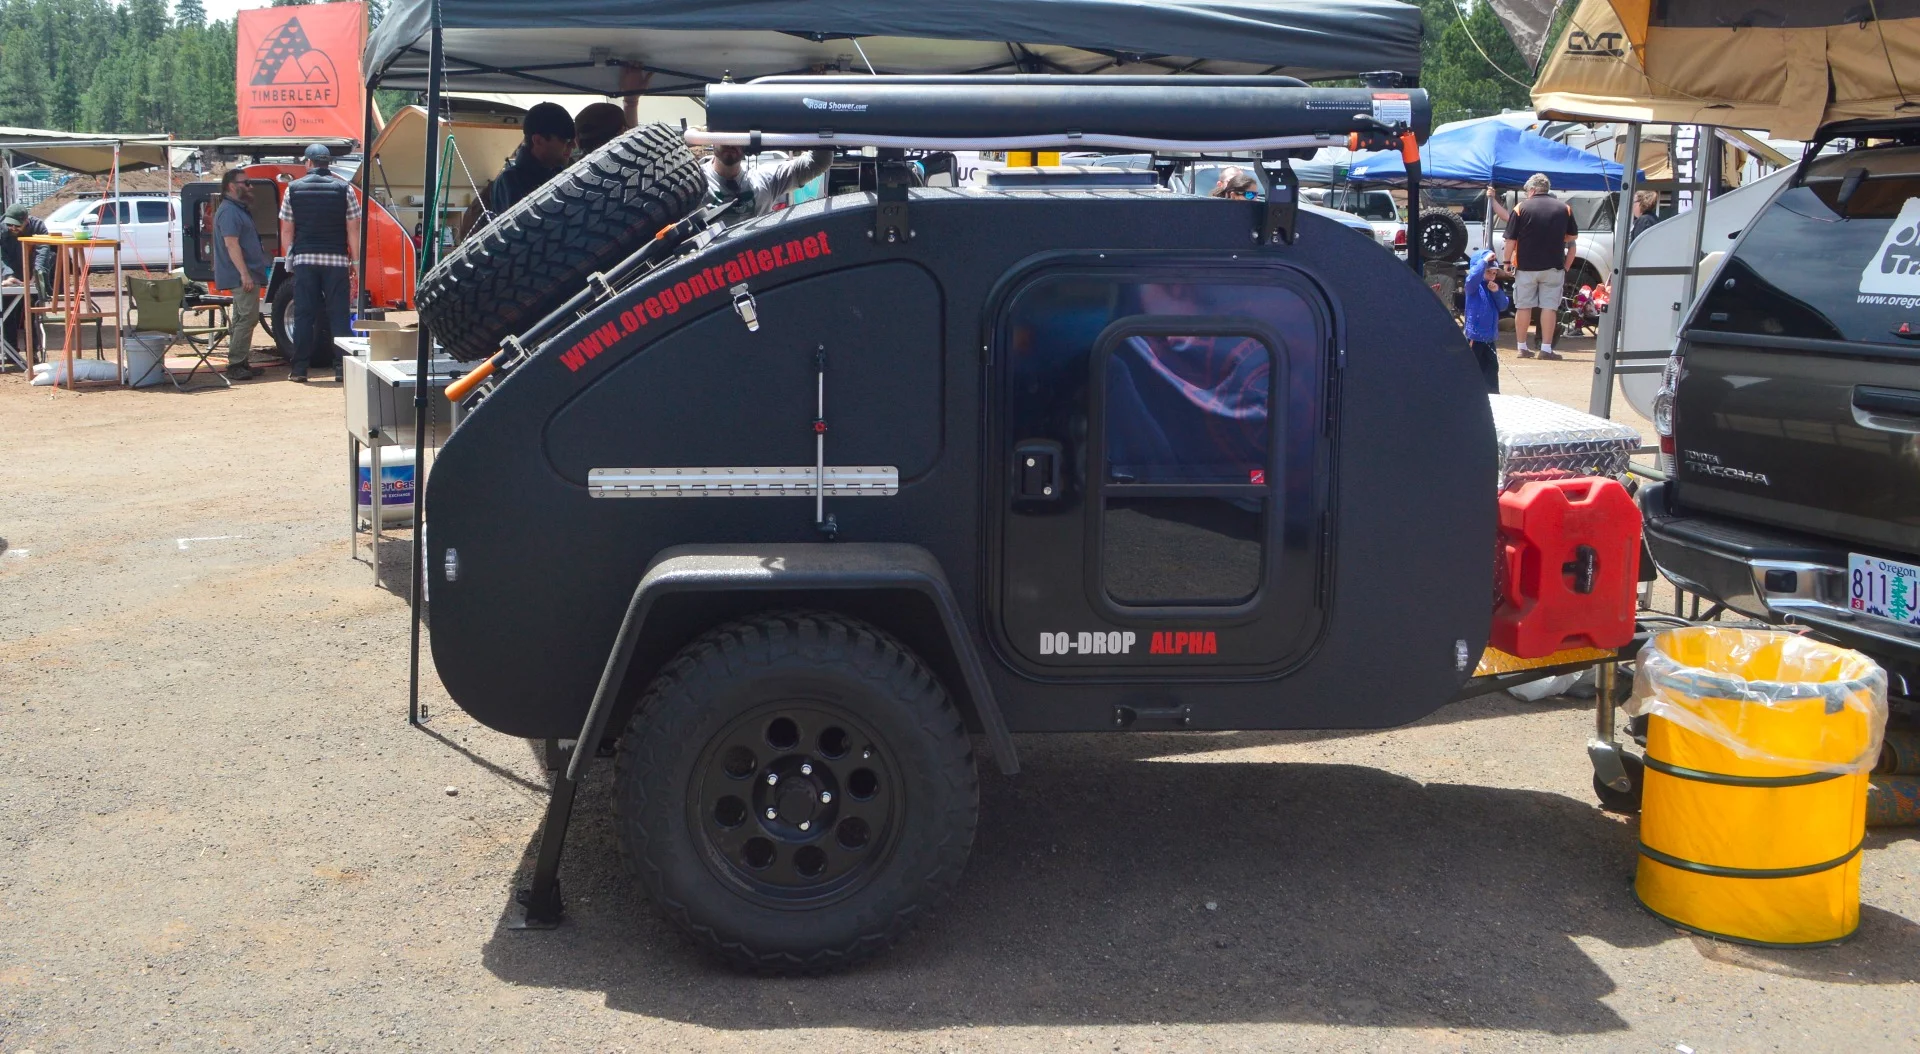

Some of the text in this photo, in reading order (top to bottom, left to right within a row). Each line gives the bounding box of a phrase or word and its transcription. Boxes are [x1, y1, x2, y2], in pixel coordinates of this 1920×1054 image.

[1568, 32, 1622, 50] CVT
[252, 88, 331, 101] TIMBERLEAF
[809, 101, 827, 110] Road
[559, 231, 832, 373] www.oregontrailer.net
[1684, 449, 1720, 464] TOYOTA
[1685, 460, 1769, 486] TACOMA
[1878, 561, 1917, 578] Oregon
[1852, 568, 1887, 606] 811
[1854, 600, 1861, 609] 3
[1040, 631, 1218, 655] DO-DROP ALPHA
